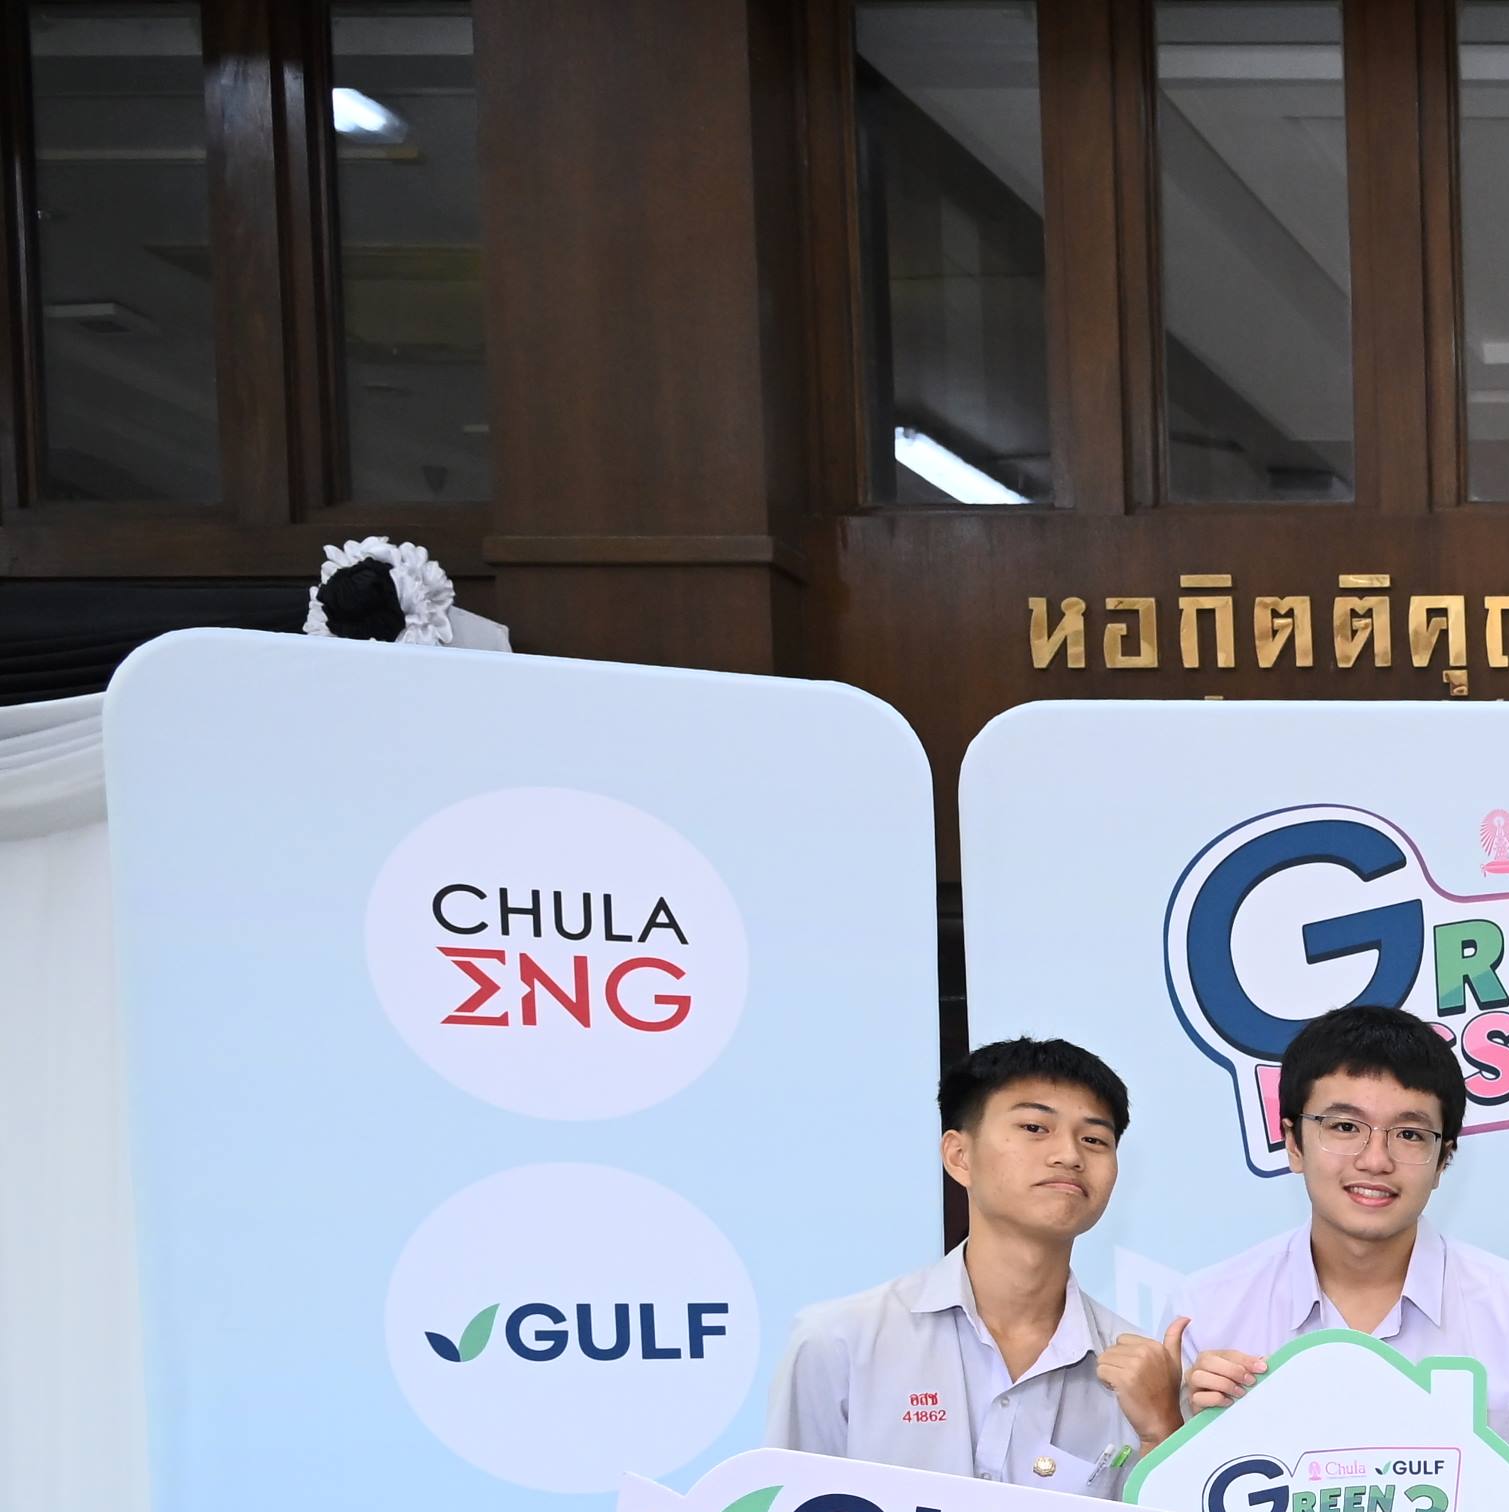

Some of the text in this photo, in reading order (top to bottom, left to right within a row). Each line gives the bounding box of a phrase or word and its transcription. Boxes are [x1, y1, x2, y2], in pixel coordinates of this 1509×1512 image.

[432, 884, 690, 946] CHULA
[505, 1303, 729, 1361] GULF
[902, 1409, 947, 1423] 41862
[1325, 1460, 1367, 1476] Chula
[1392, 1460, 1445, 1475] GULF
